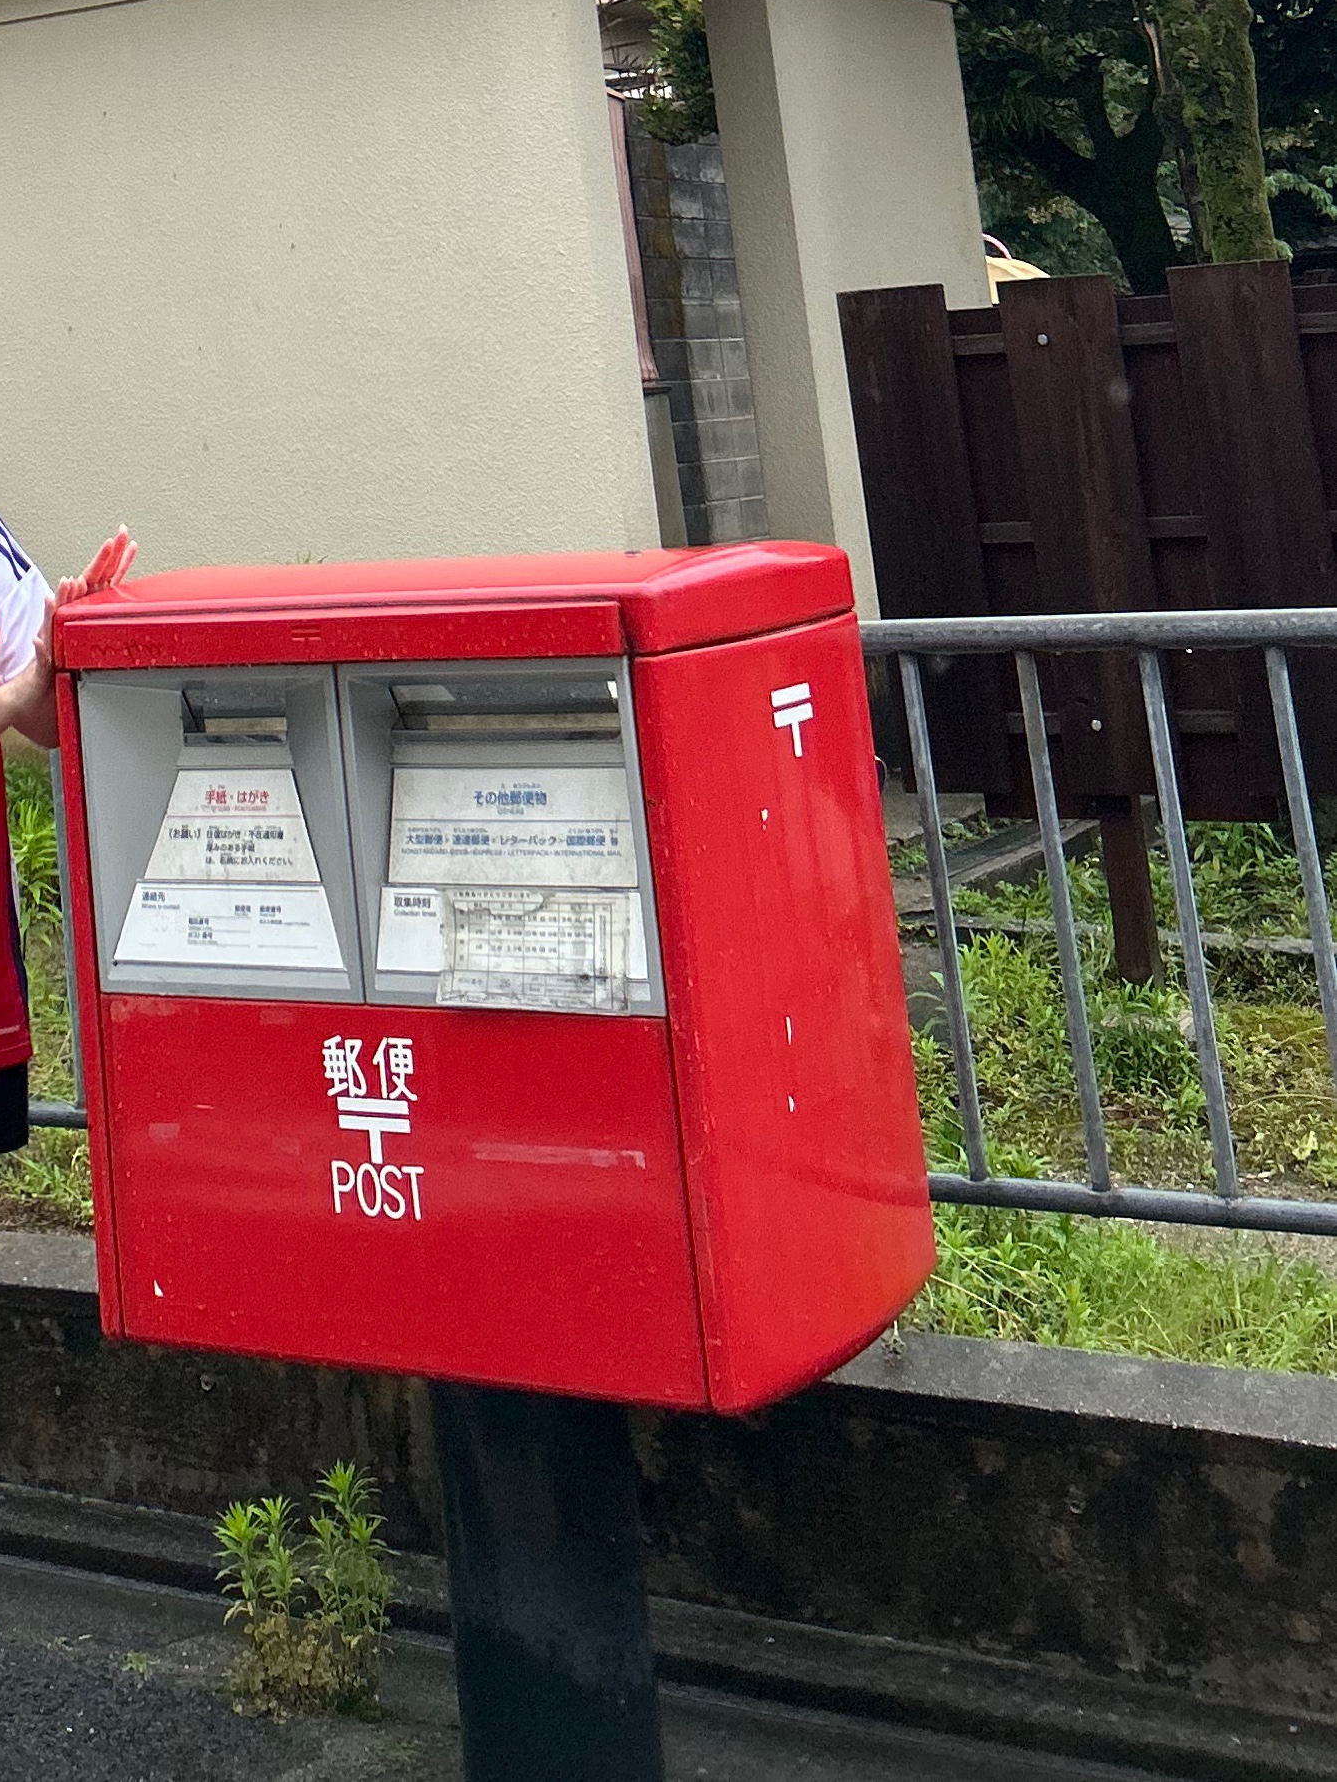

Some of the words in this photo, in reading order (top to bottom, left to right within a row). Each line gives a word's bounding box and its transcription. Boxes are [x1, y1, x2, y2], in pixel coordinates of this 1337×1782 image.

[473, 790, 547, 806] その他郵便物
[322, 1034, 418, 1101] 郵便
[331, 1160, 425, 1221] POST
